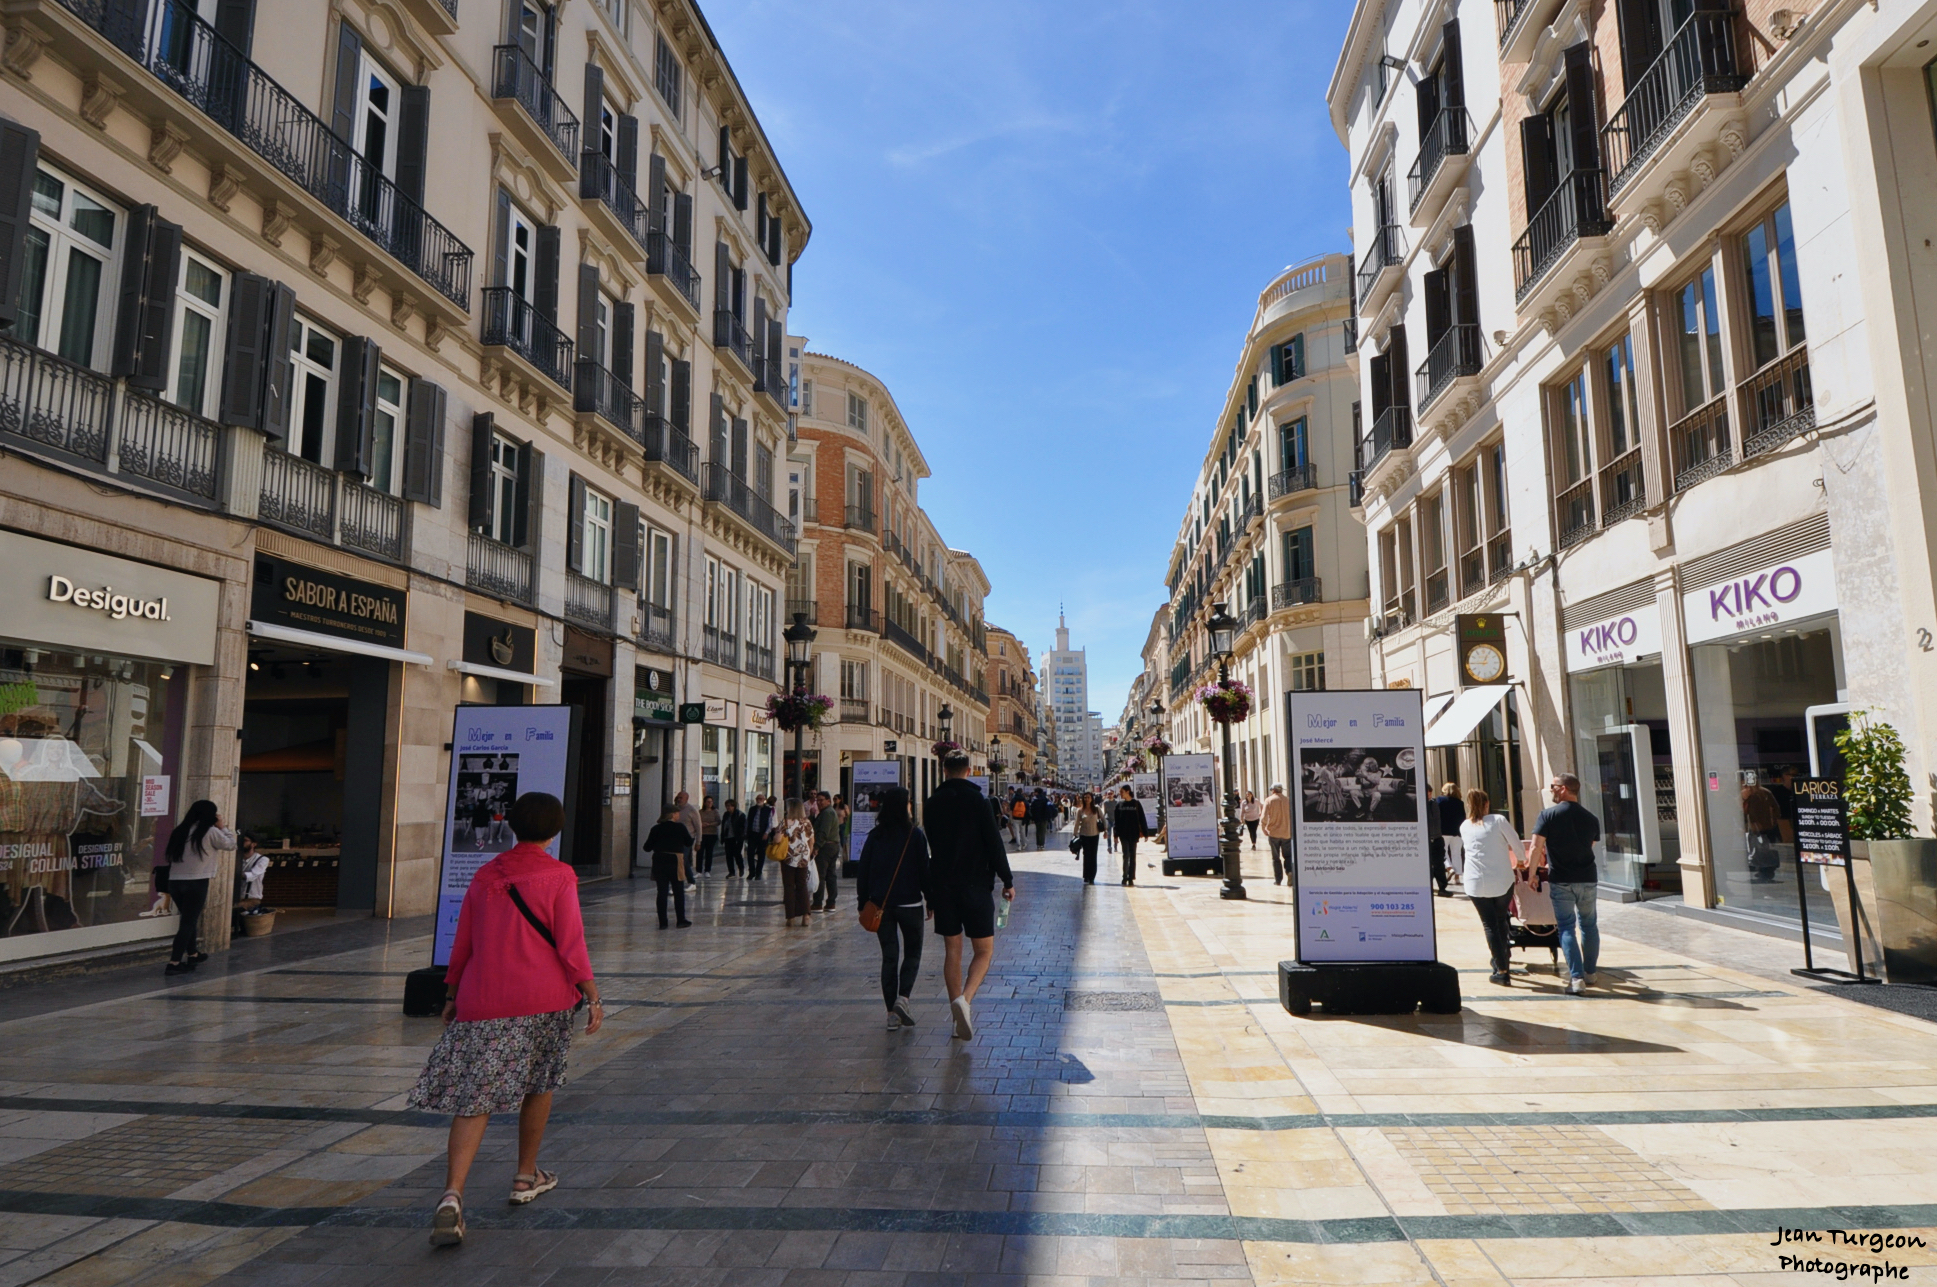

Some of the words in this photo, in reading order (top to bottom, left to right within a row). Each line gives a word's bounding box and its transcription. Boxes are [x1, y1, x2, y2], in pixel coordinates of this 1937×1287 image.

[48, 575, 171, 621] Desigual.
[285, 577, 336, 610] SABOR
[338, 591, 348, 613] A
[351, 593, 398, 625] ESPAÑA
[1710, 566, 1802, 621] KIKO
[290, 611, 321, 623] MAESTROS
[322, 619, 357, 632] TURRONEROS
[358, 625, 374, 635] DESDE
[1736, 611, 1779, 630] MILANO
[1580, 617, 1637, 656] KIKO
[1916, 627, 1935, 653] 22
[1596, 651, 1624, 664] MILANO
[635, 698, 646, 709] THE
[646, 699, 660, 710] BODY
[1306, 713, 1337, 729] Mejor
[1349, 719, 1358, 727] en
[1372, 713, 1405, 728] Familia
[468, 727, 495, 743] Mejor
[504, 733, 512, 741] en
[525, 727, 554, 741] Familia
[1794, 781, 1838, 802] LARIOS
[0, 842, 53, 859] ESIGUAL
[78, 844, 113, 855] DESIGNED
[114, 842, 124, 852] BY
[30, 857, 78, 874] COLLINA
[81, 853, 124, 870] STRADA
